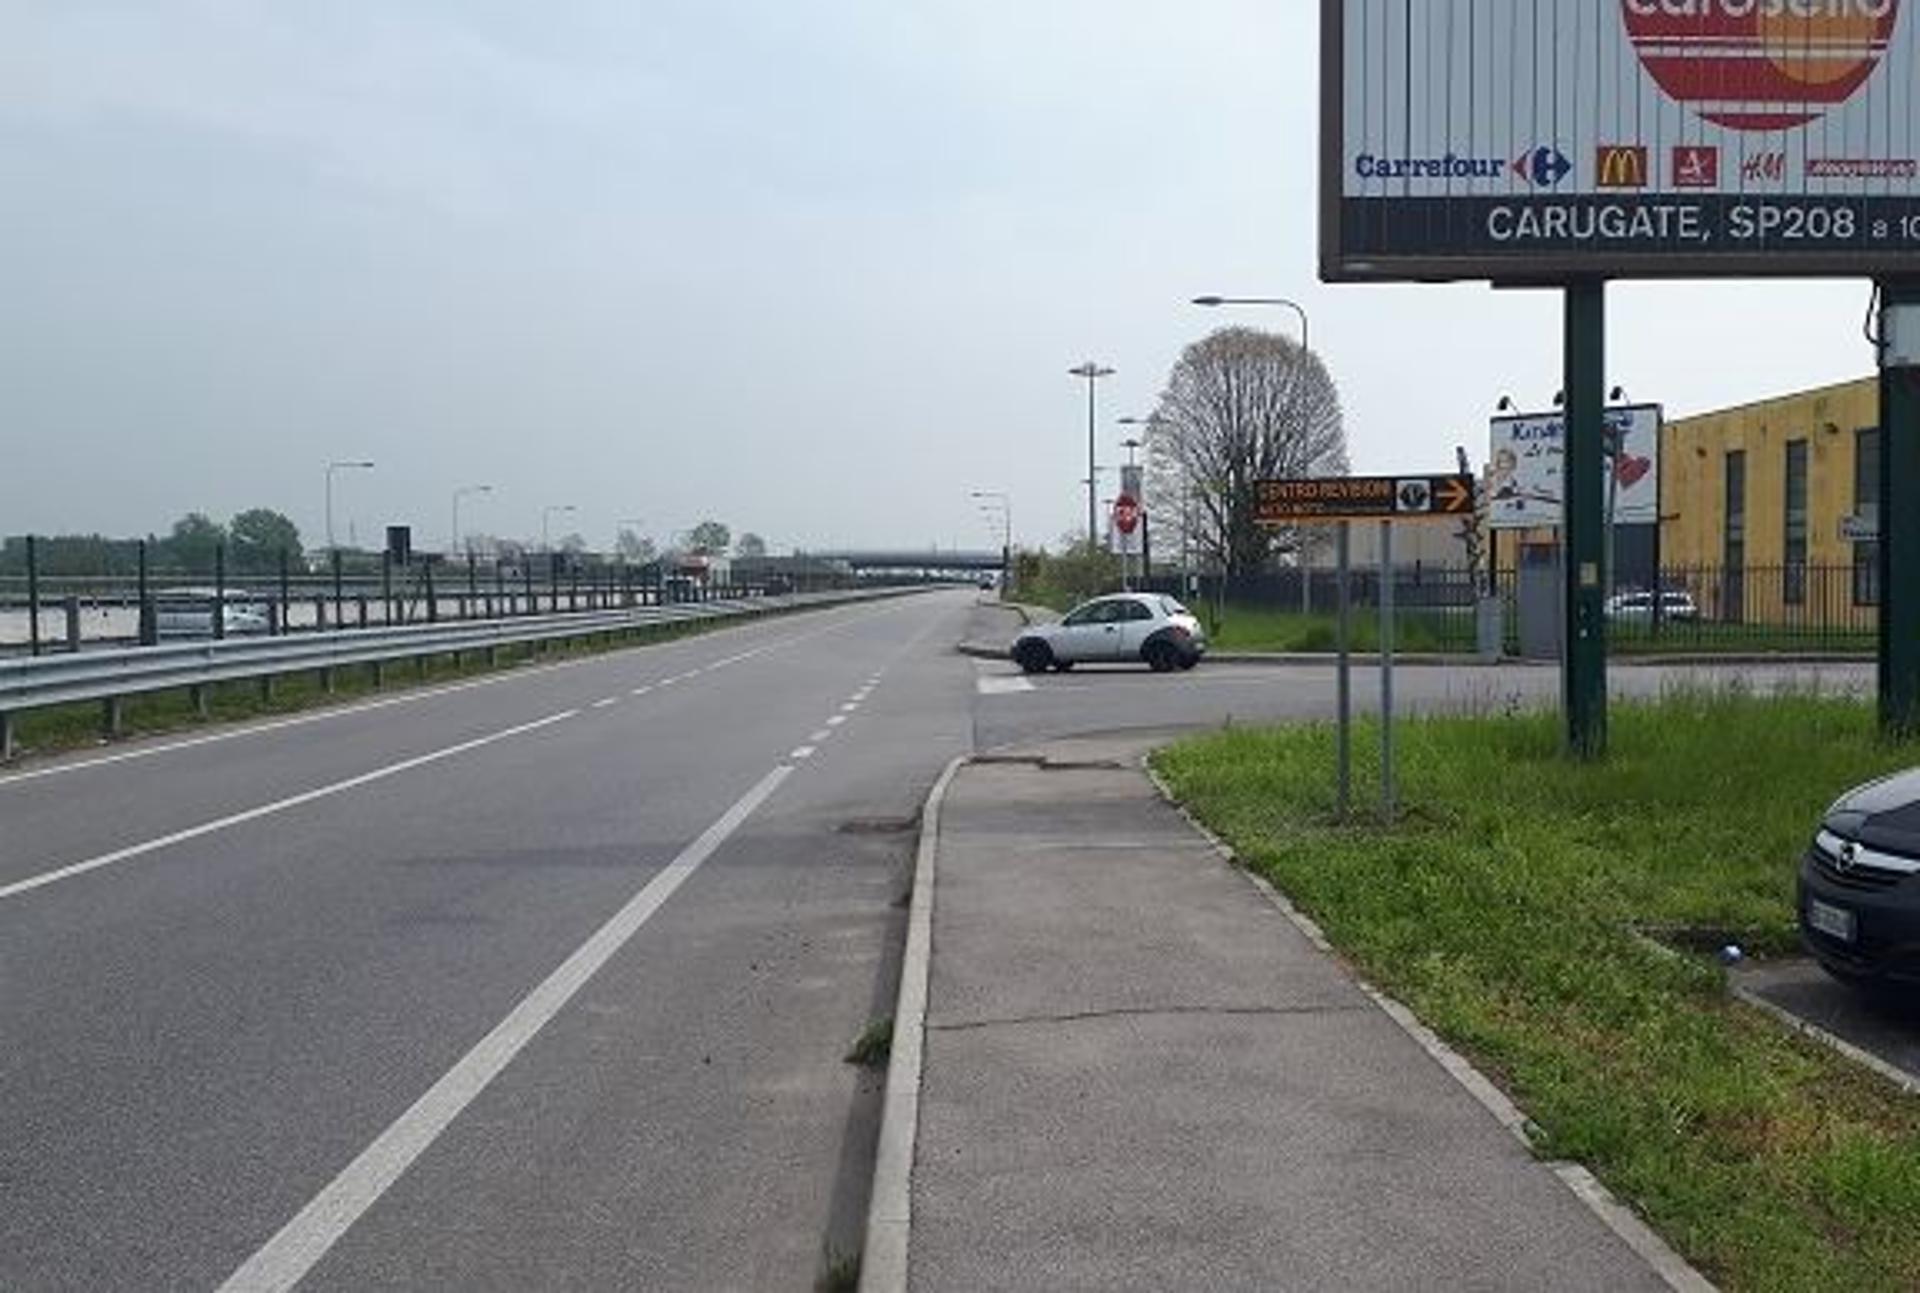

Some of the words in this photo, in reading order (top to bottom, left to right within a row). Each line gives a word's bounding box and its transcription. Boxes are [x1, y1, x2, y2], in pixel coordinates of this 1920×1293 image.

[1355, 154, 1506, 178] Carrefour
[1488, 205, 1711, 241] CARUGATE,
[1728, 205, 1856, 238] SP208
[1872, 219, 1888, 237] a
